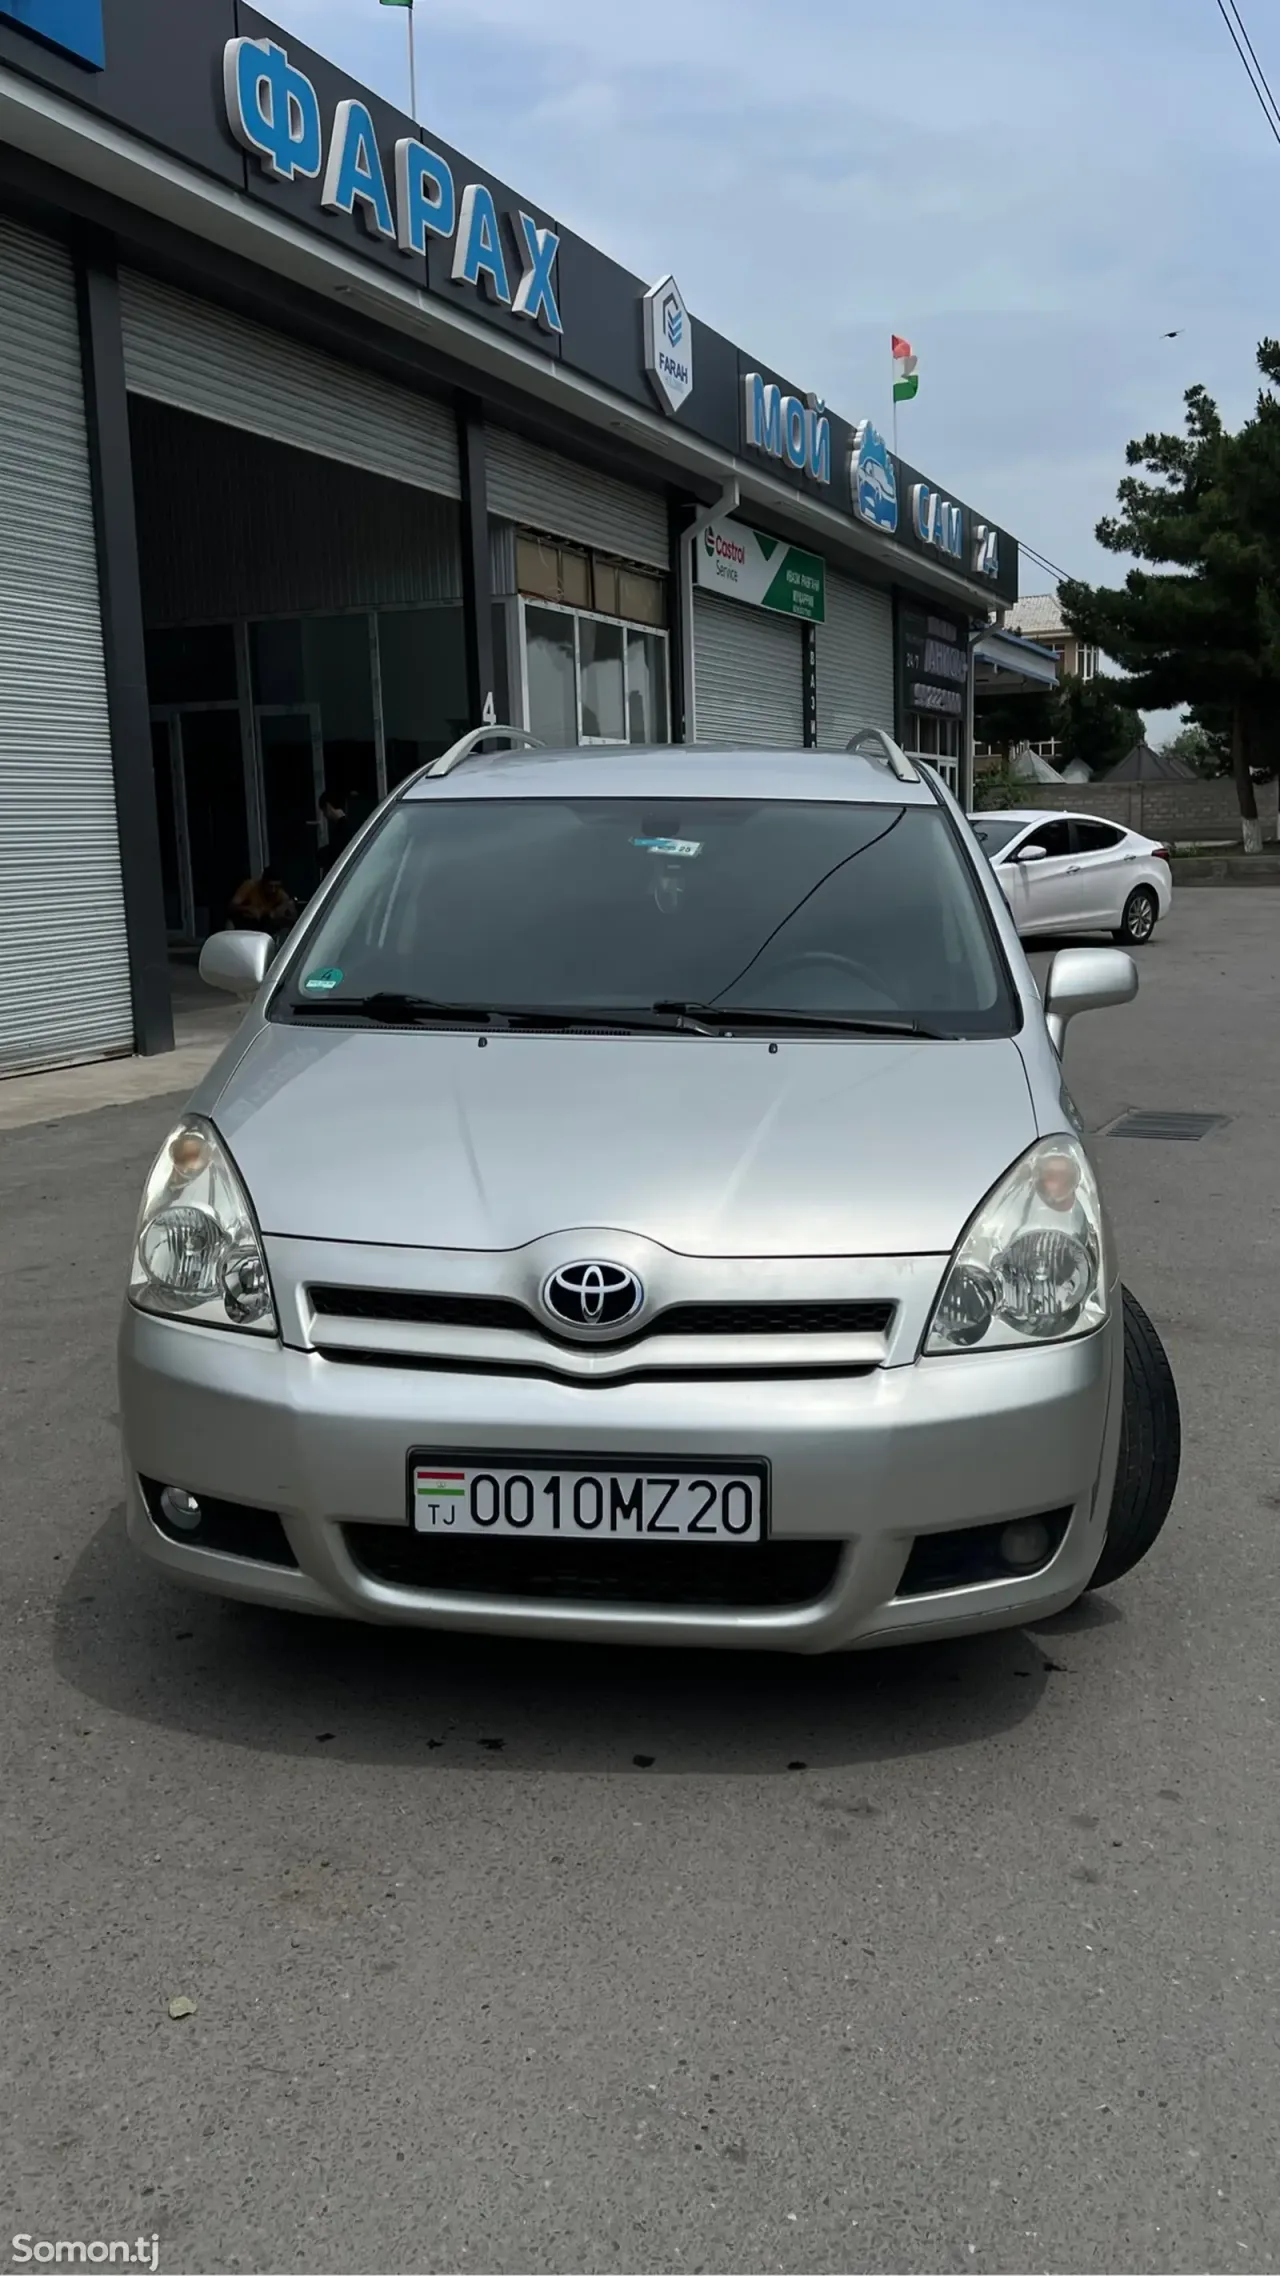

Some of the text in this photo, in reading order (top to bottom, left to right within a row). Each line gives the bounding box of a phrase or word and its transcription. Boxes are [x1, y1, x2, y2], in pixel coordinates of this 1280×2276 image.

[224, 36, 563, 335] ФАРАХ
[658, 352, 688, 385] FARAH
[745, 372, 999, 579] МОЙ САМ 24
[715, 535, 746, 565] Castrol
[715, 559, 739, 583] Service
[482, 691, 497, 726] 4
[427, 1504, 456, 1526] TJ
[470, 1474, 752, 1535] 0010MZ20
